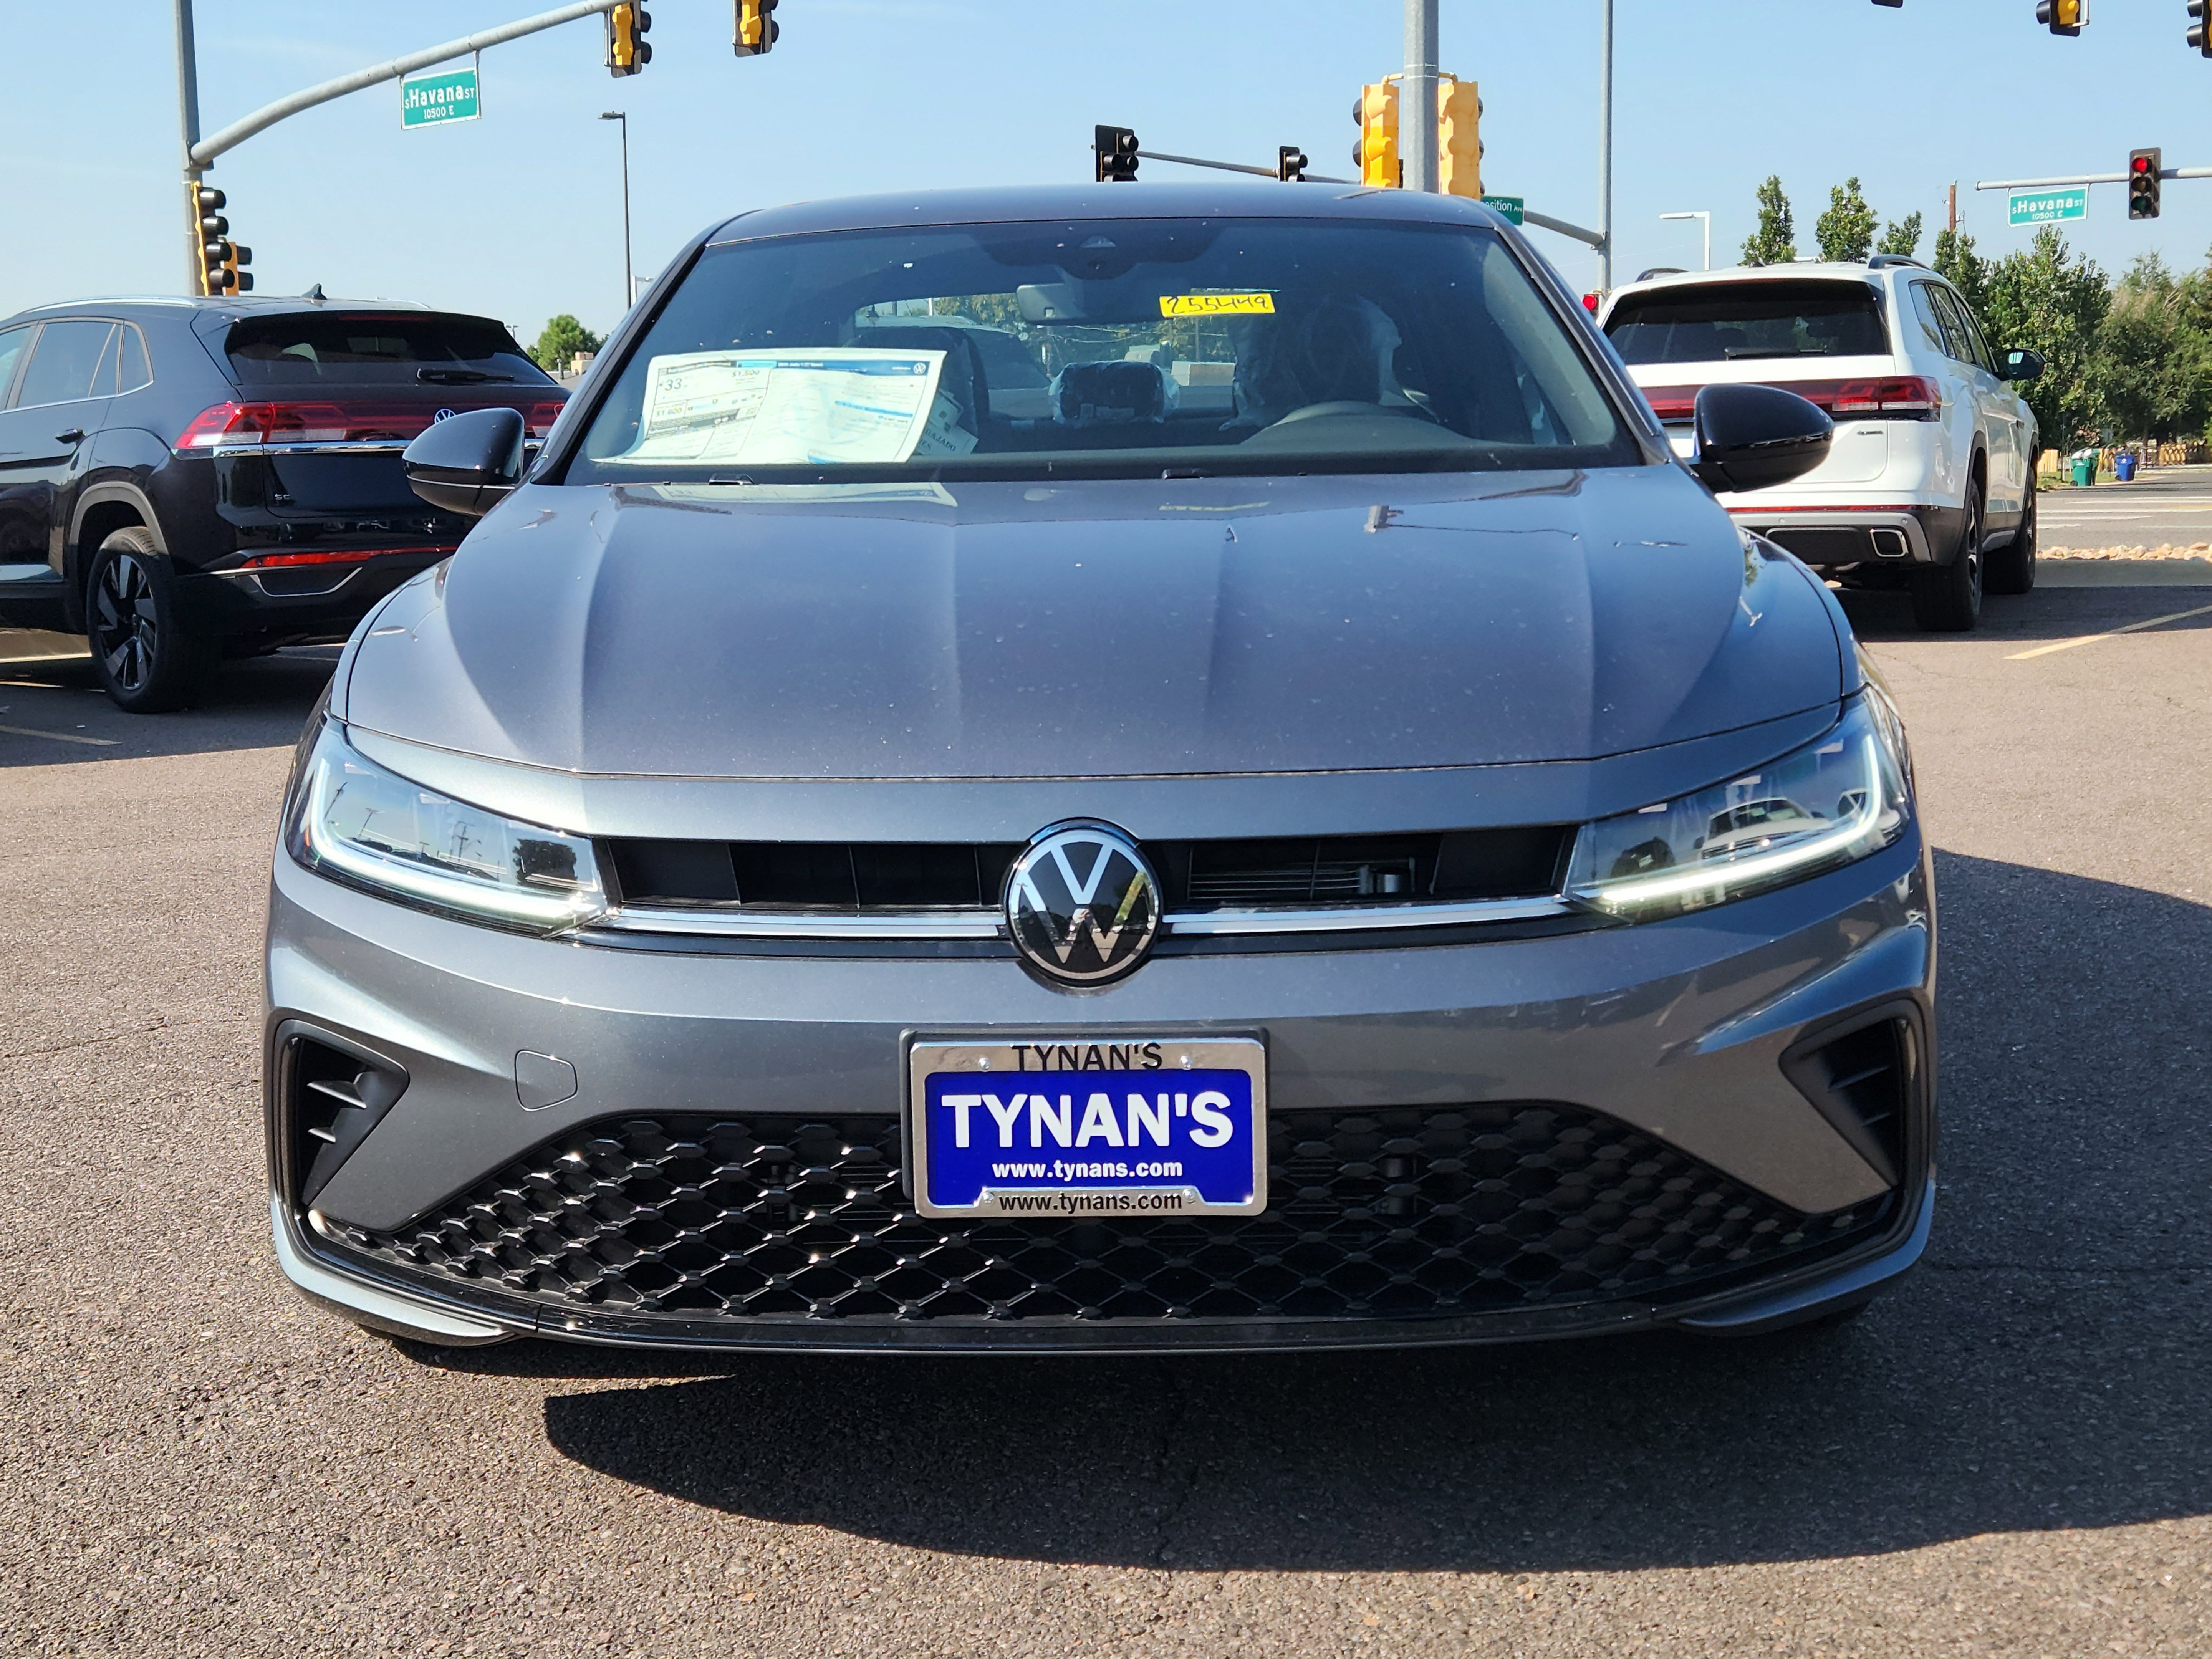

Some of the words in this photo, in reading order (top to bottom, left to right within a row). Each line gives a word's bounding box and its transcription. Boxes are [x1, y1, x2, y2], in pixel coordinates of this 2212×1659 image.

[409, 85, 464, 108] Havana
[464, 88, 475, 99] ST
[424, 106, 446, 119] 10500
[449, 105, 454, 116] E
[2017, 198, 2073, 214] Havana
[1167, 296, 1268, 315] 255449
[664, 378, 682, 391] 33
[1011, 1042, 1163, 1071] TYNAN'S
[941, 1090, 1234, 1148] TYNAN'S
[992, 1159, 1182, 1182] www.tynans.com
[998, 1191, 1182, 1214] www.tynans.com
